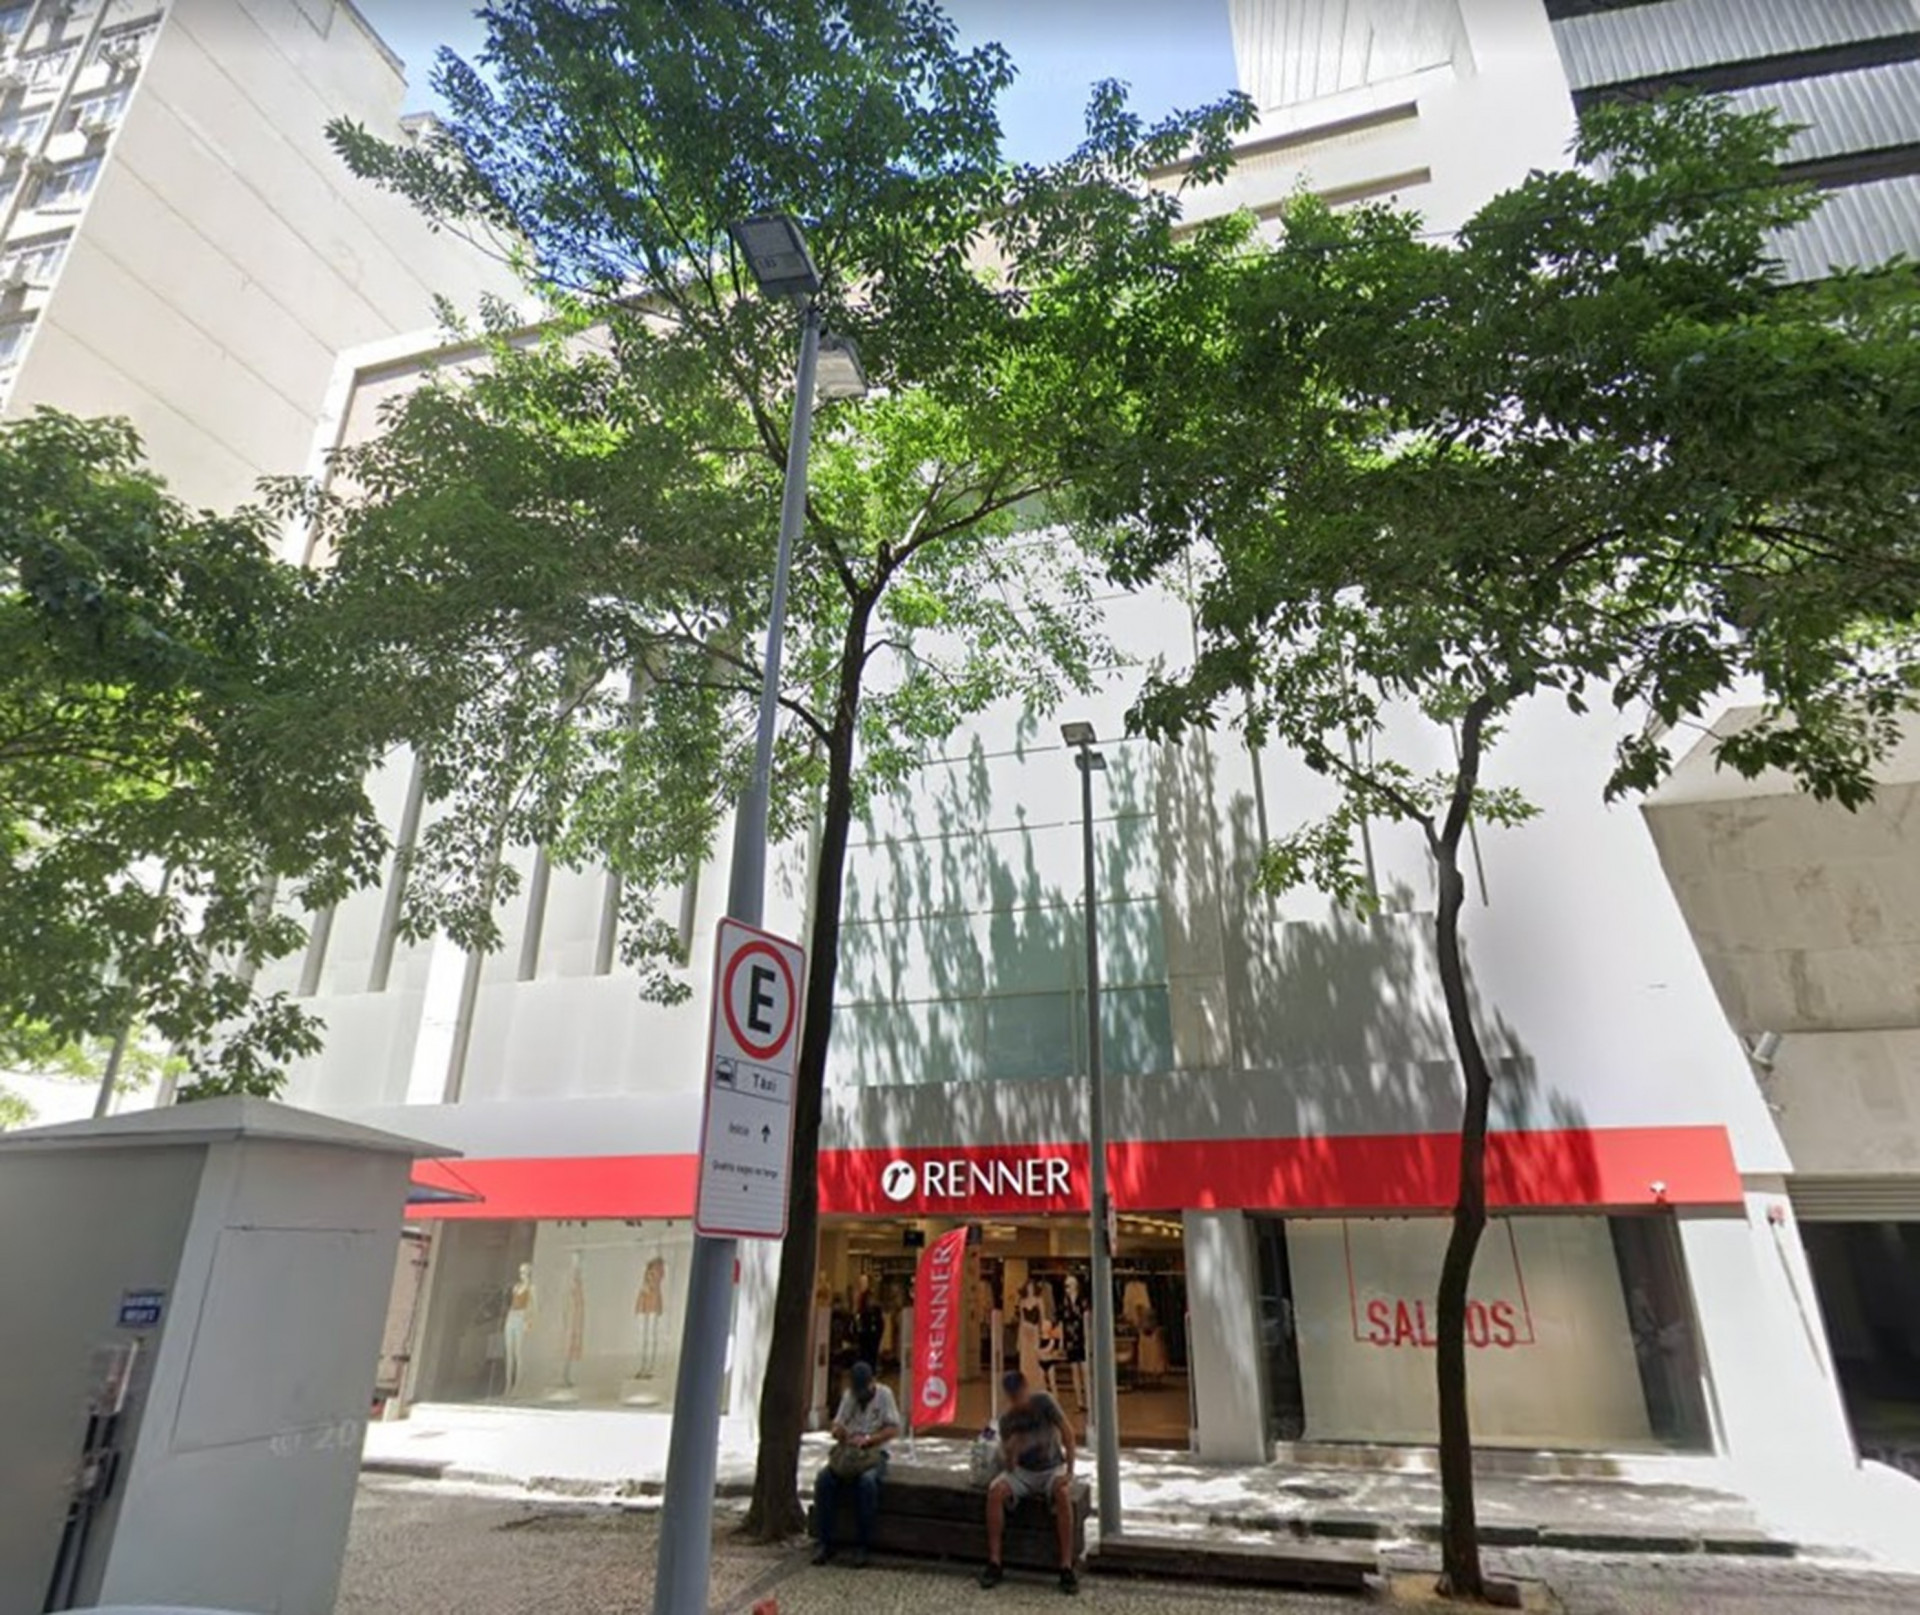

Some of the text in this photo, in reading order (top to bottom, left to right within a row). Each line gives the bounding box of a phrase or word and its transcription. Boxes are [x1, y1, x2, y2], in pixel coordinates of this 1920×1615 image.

[747, 964, 776, 1034] E
[923, 1158, 1071, 1197] RENNER
[928, 1247, 951, 1369] RENNER
[1367, 1299, 1517, 1348] SALOS
